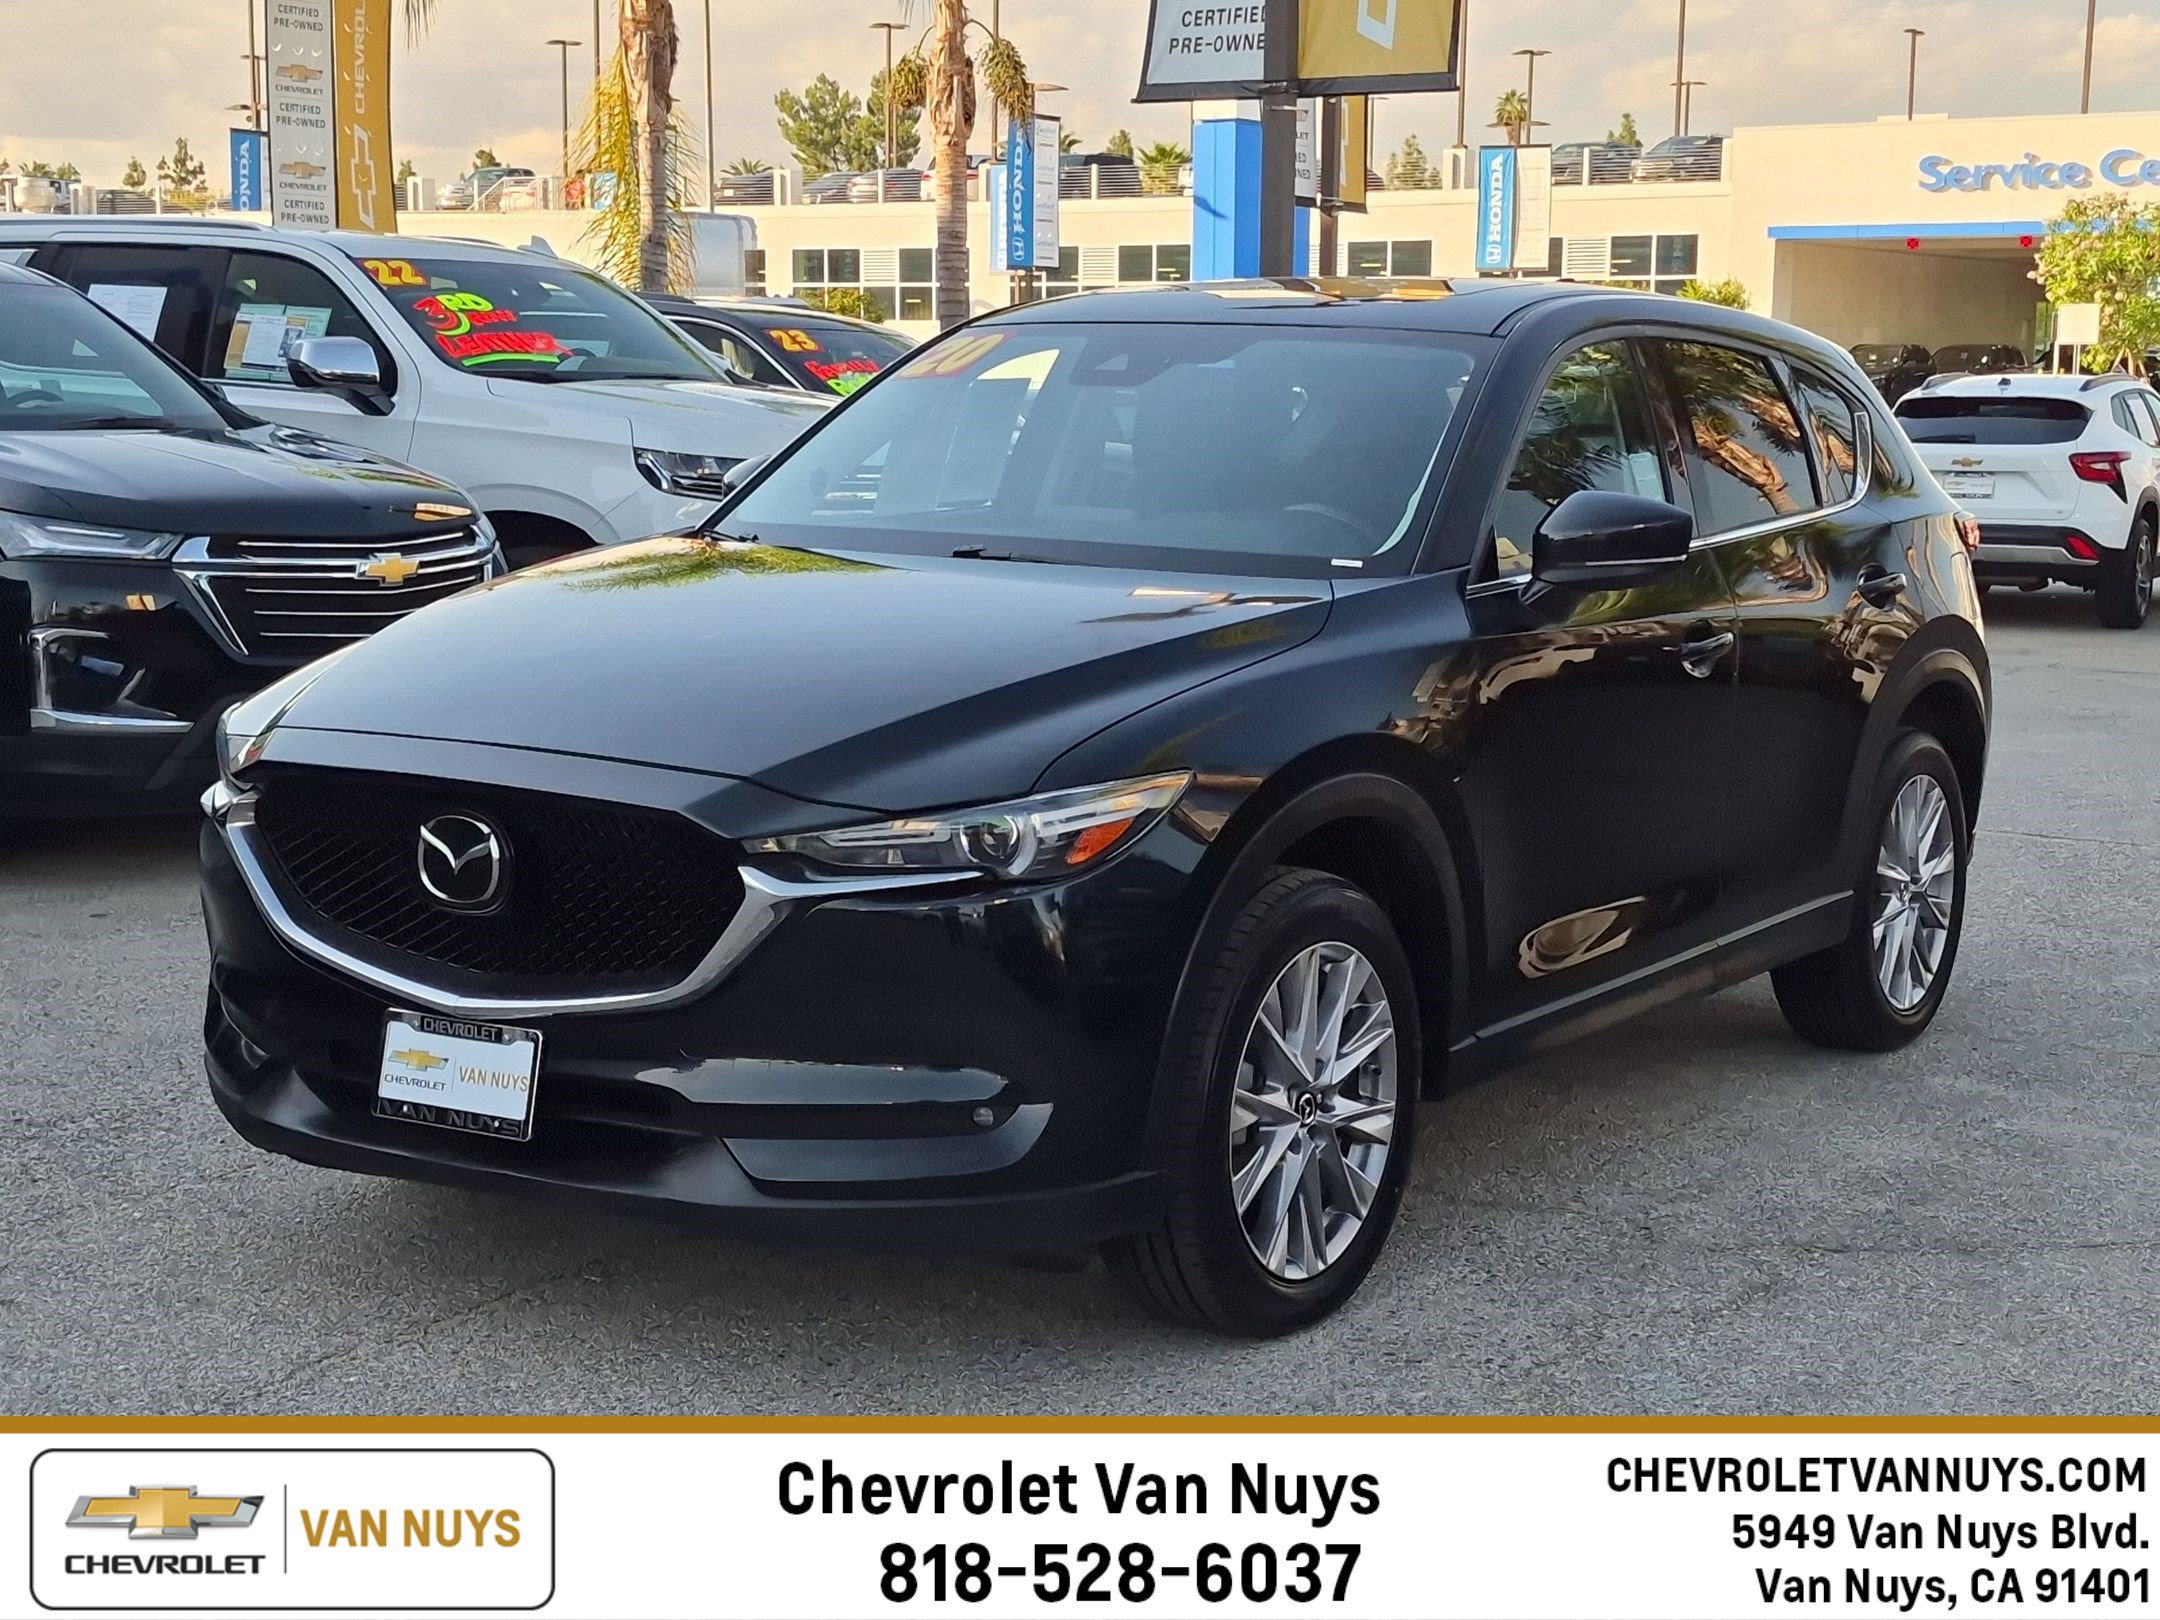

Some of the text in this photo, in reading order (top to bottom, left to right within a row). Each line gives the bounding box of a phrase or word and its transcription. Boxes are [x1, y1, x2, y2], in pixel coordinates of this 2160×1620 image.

[278, 4, 319, 18] CERTIFIED
[273, 17, 323, 32] PRE-OWNED
[275, 84, 324, 96] CHEVROLET
[279, 102, 321, 115] CERTIFIED
[276, 115, 326, 129] PRE-OWNED
[1918, 152, 2088, 192] Service
[279, 181, 328, 192] CHEVROLET
[284, 199, 325, 211] CERTIFIED
[1489, 153, 1504, 241] HONDA
[280, 213, 330, 225] PRE-OWNED
[363, 259, 427, 286] 22
[769, 329, 817, 351] 23
[423, 1017, 498, 1041] CHEVROLET
[384, 1073, 447, 1092] CHEVROLET
[459, 1065, 529, 1093] VAN NUYS
[381, 1099, 520, 1136] VAN NUYS
